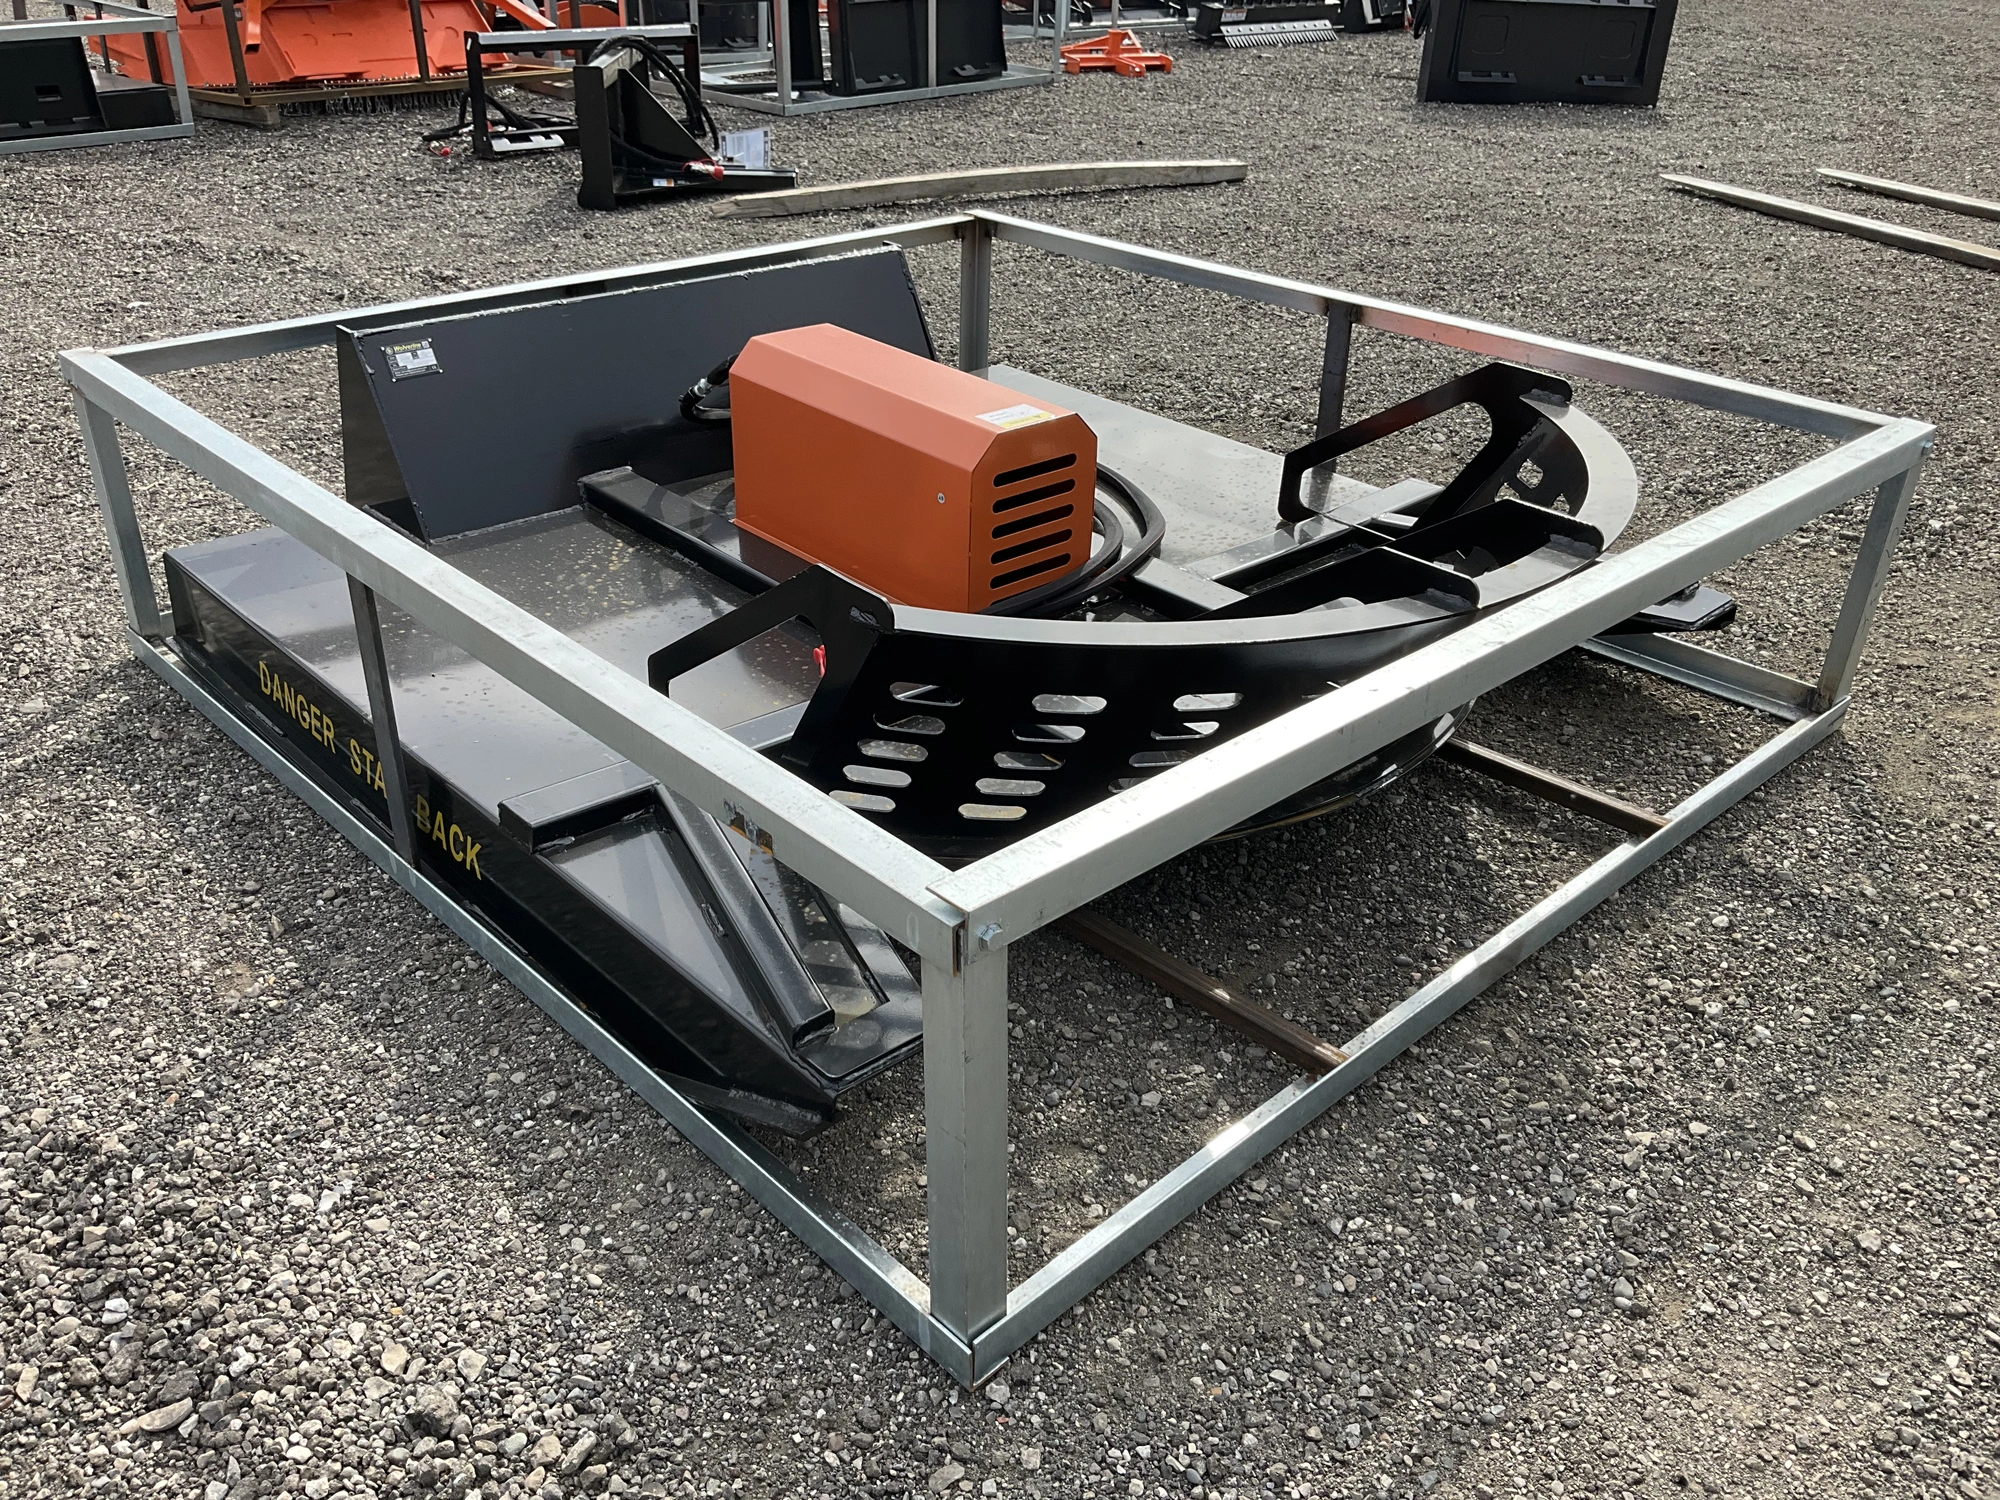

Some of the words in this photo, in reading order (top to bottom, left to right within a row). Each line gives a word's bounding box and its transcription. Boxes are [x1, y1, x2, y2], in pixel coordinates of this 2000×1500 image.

[259, 661, 336, 754] DANGER
[350, 738, 388, 798] STA
[417, 794, 482, 880] BACK
